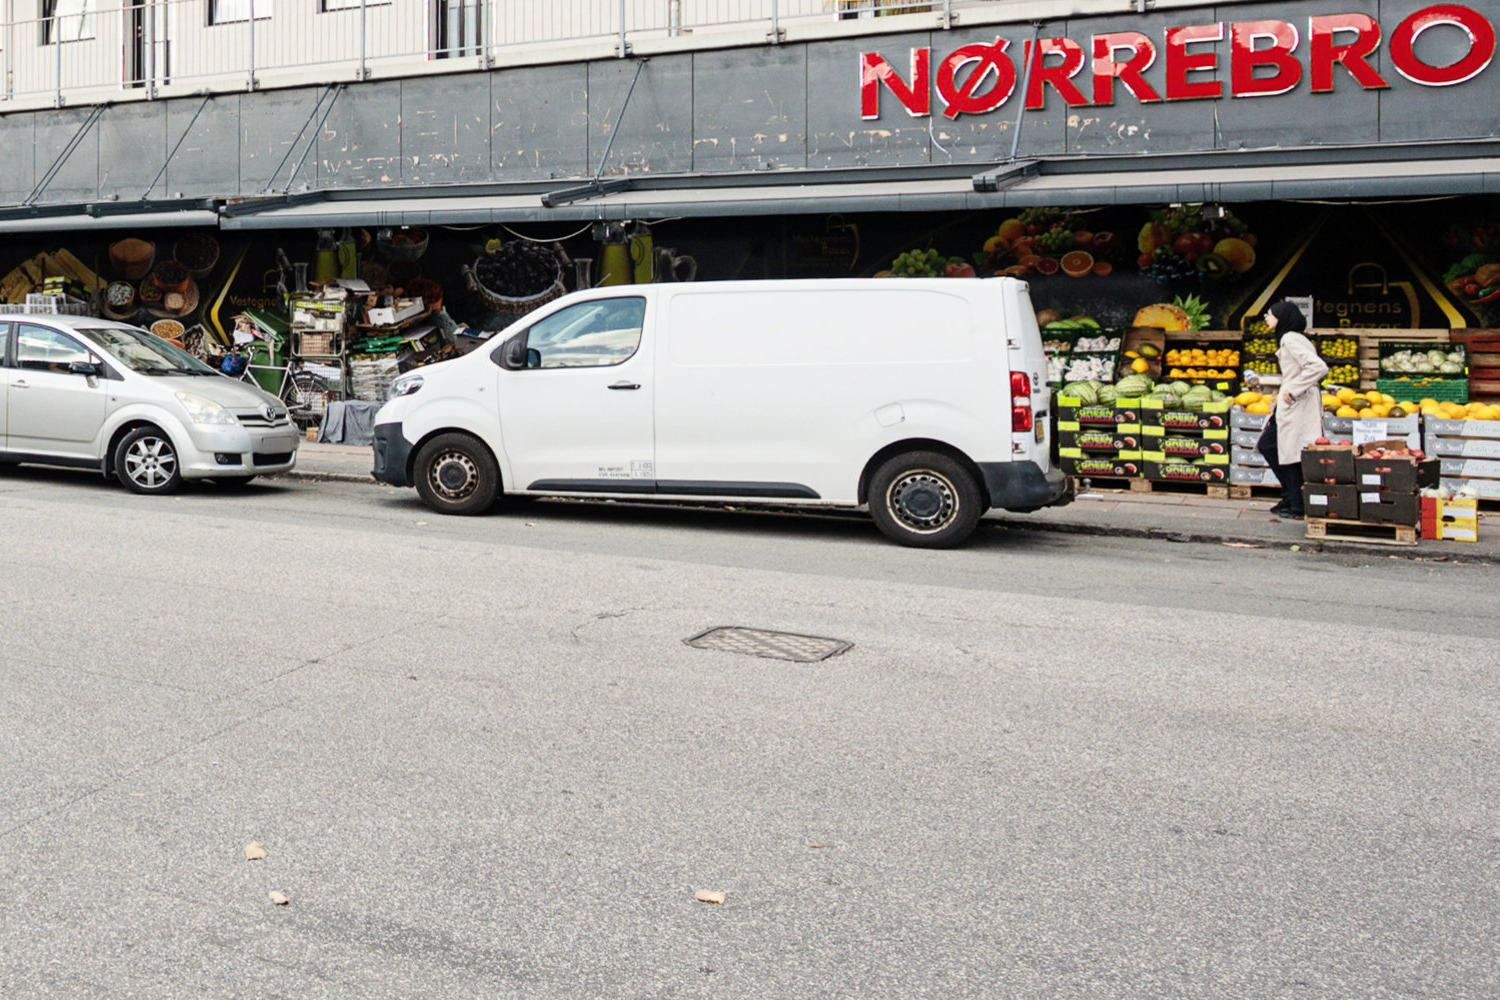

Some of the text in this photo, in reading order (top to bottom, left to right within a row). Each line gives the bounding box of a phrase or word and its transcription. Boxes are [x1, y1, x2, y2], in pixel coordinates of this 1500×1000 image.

[860, 3, 1496, 120] NØRREBRO
[1315, 299, 1403, 317] tegnens
[1079, 409, 1114, 417] GREEN
[1164, 414, 1198, 422] GREEN
[1080, 435, 1114, 443] GREEN
[1164, 440, 1199, 448] GREEN
[1165, 466, 1199, 474] GREEN
